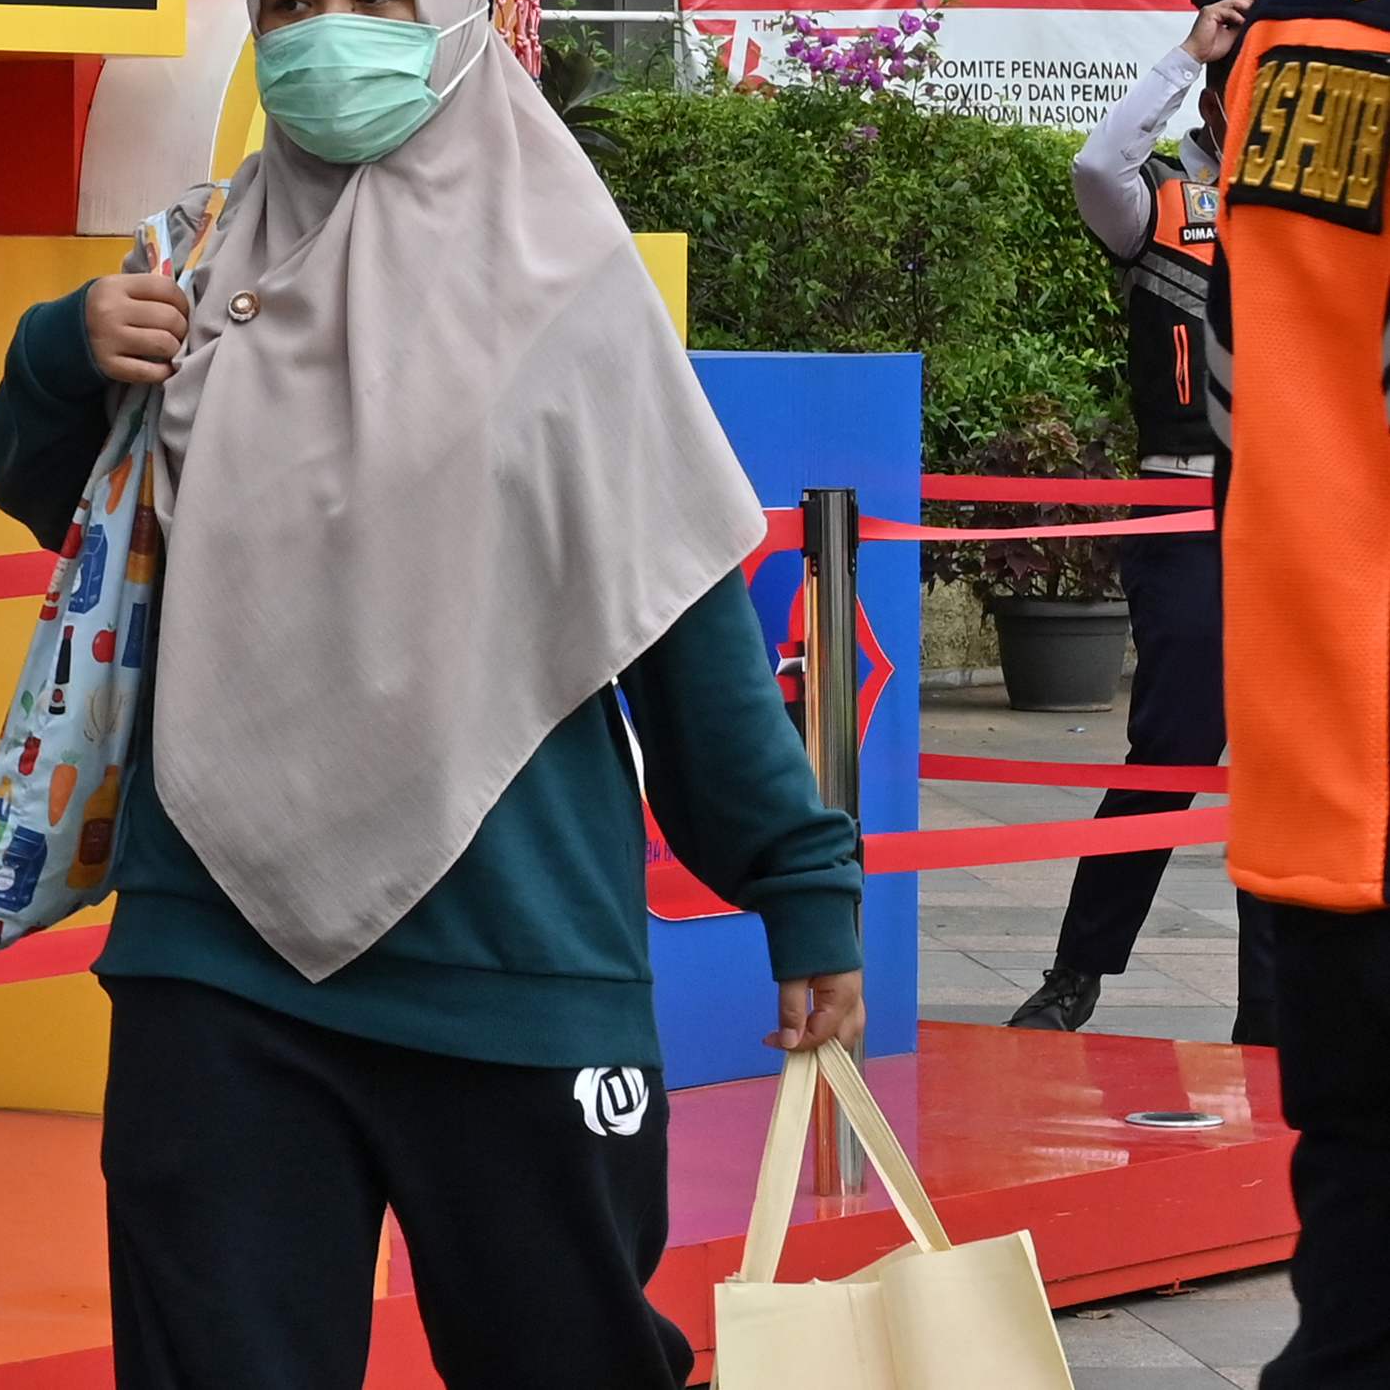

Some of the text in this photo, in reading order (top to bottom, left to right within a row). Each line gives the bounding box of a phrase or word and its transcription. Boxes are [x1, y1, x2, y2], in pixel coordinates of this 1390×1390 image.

[929, 60, 1138, 80] KOMITE PENANGANAN
[1028, 83, 1065, 102] DAN
[1183, 227, 1219, 242] DIMA
